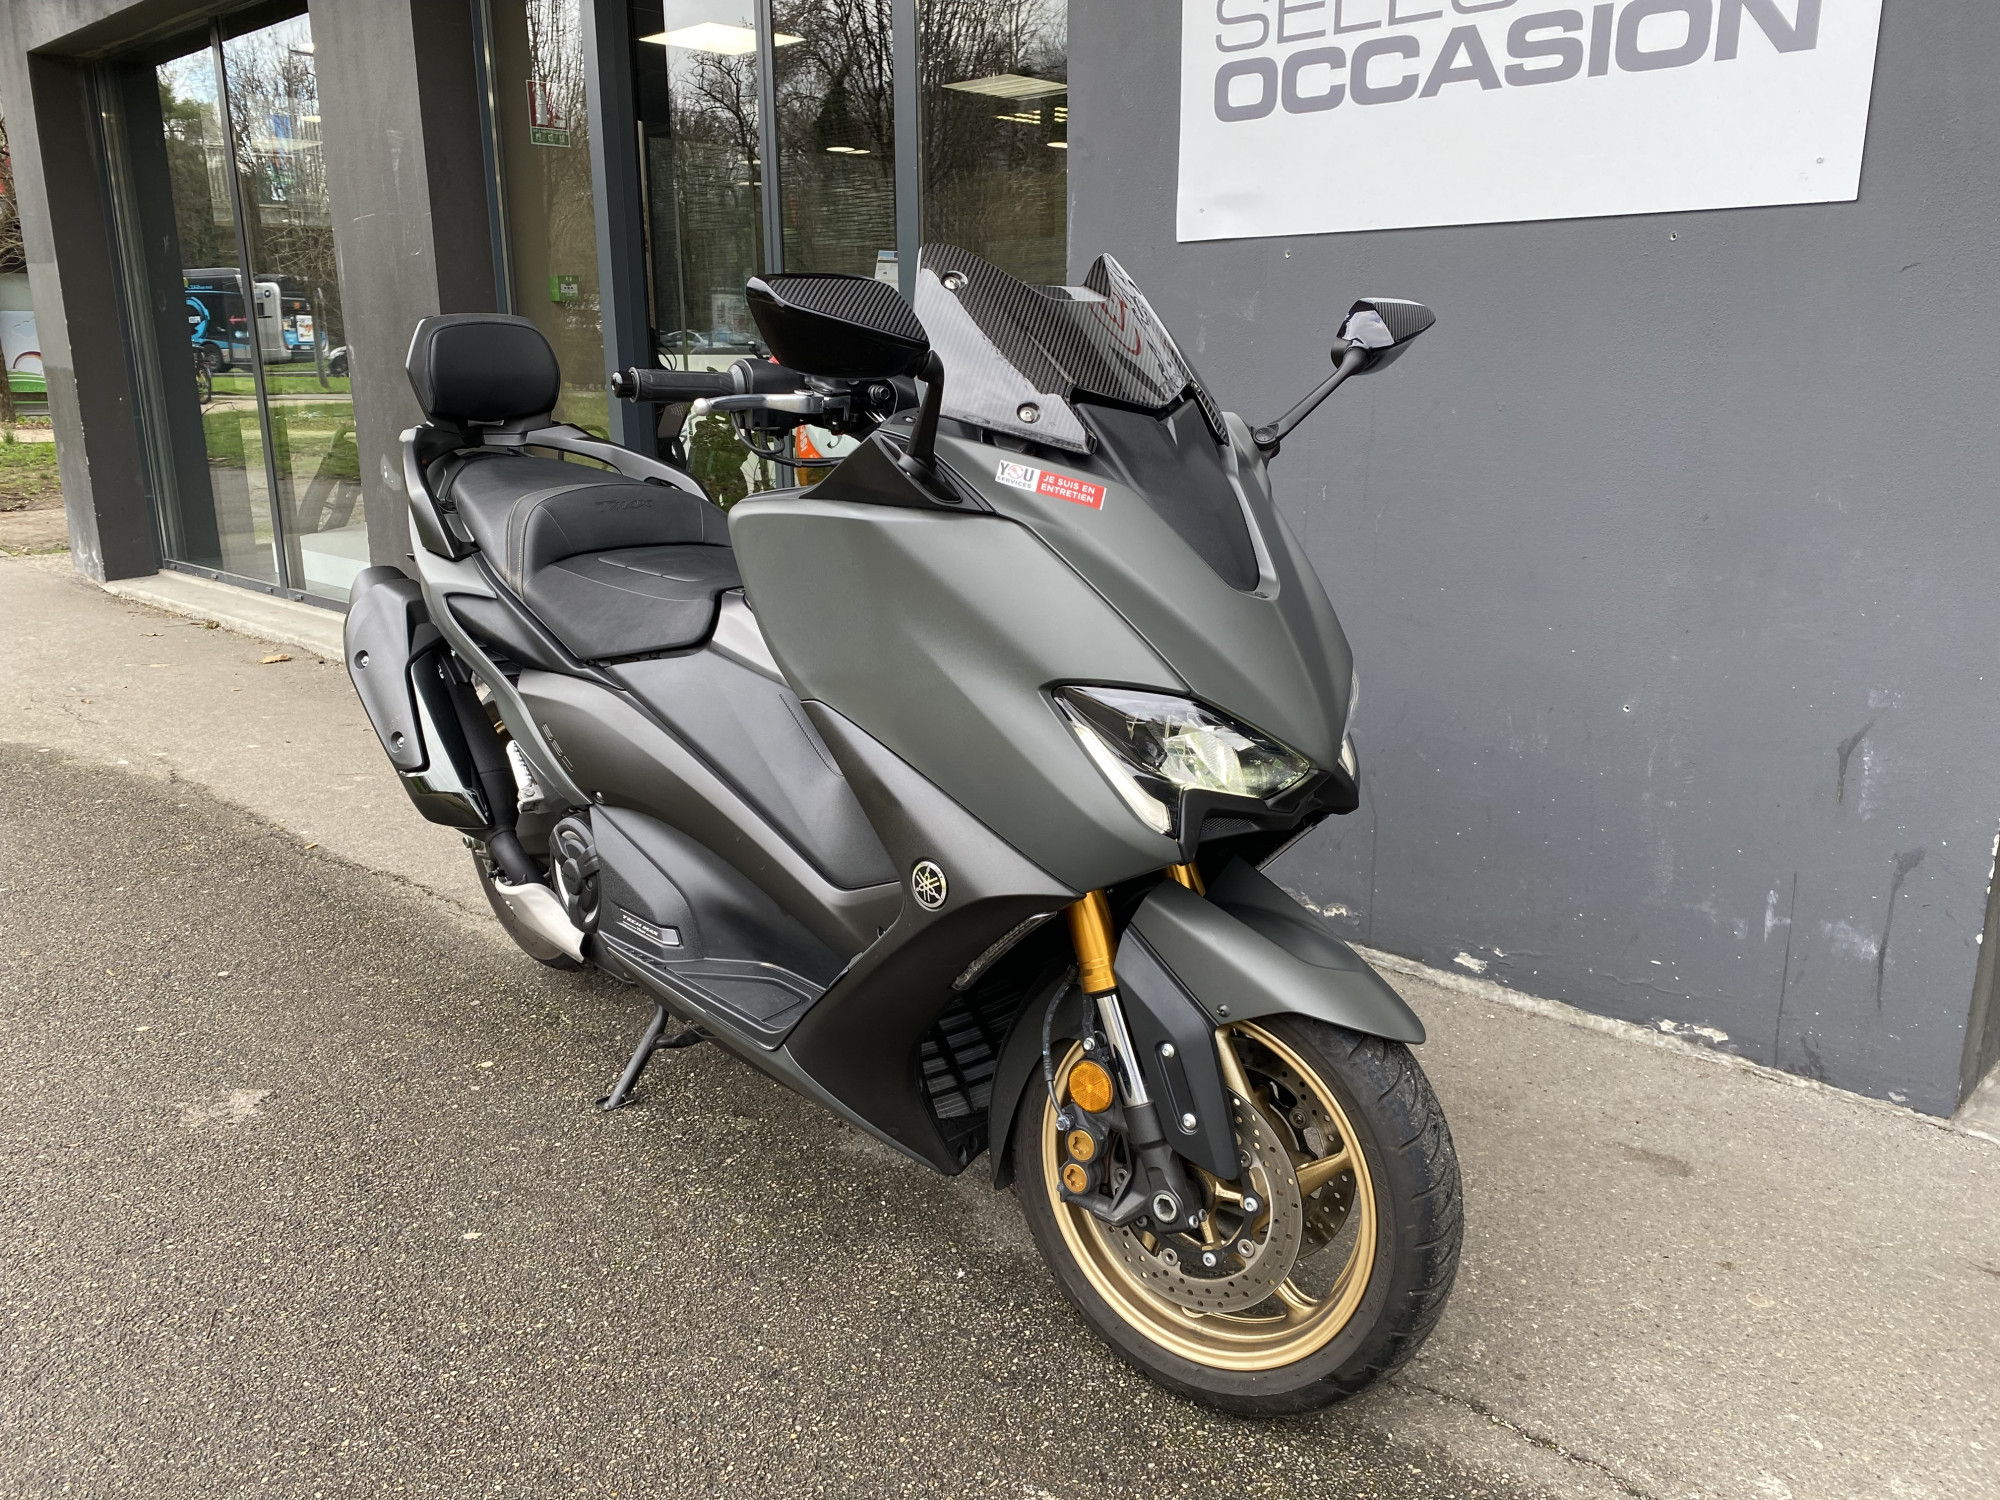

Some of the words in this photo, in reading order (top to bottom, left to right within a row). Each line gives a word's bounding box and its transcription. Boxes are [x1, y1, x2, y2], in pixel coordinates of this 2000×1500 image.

[1214, 0, 1822, 122] OCCASION
[997, 476, 1032, 489] SERVICES
[1043, 474, 1056, 484] JE
[1057, 478, 1080, 490] SUIS
[1082, 485, 1096, 495] EN
[1041, 484, 1094, 503] ENTRETIEN
